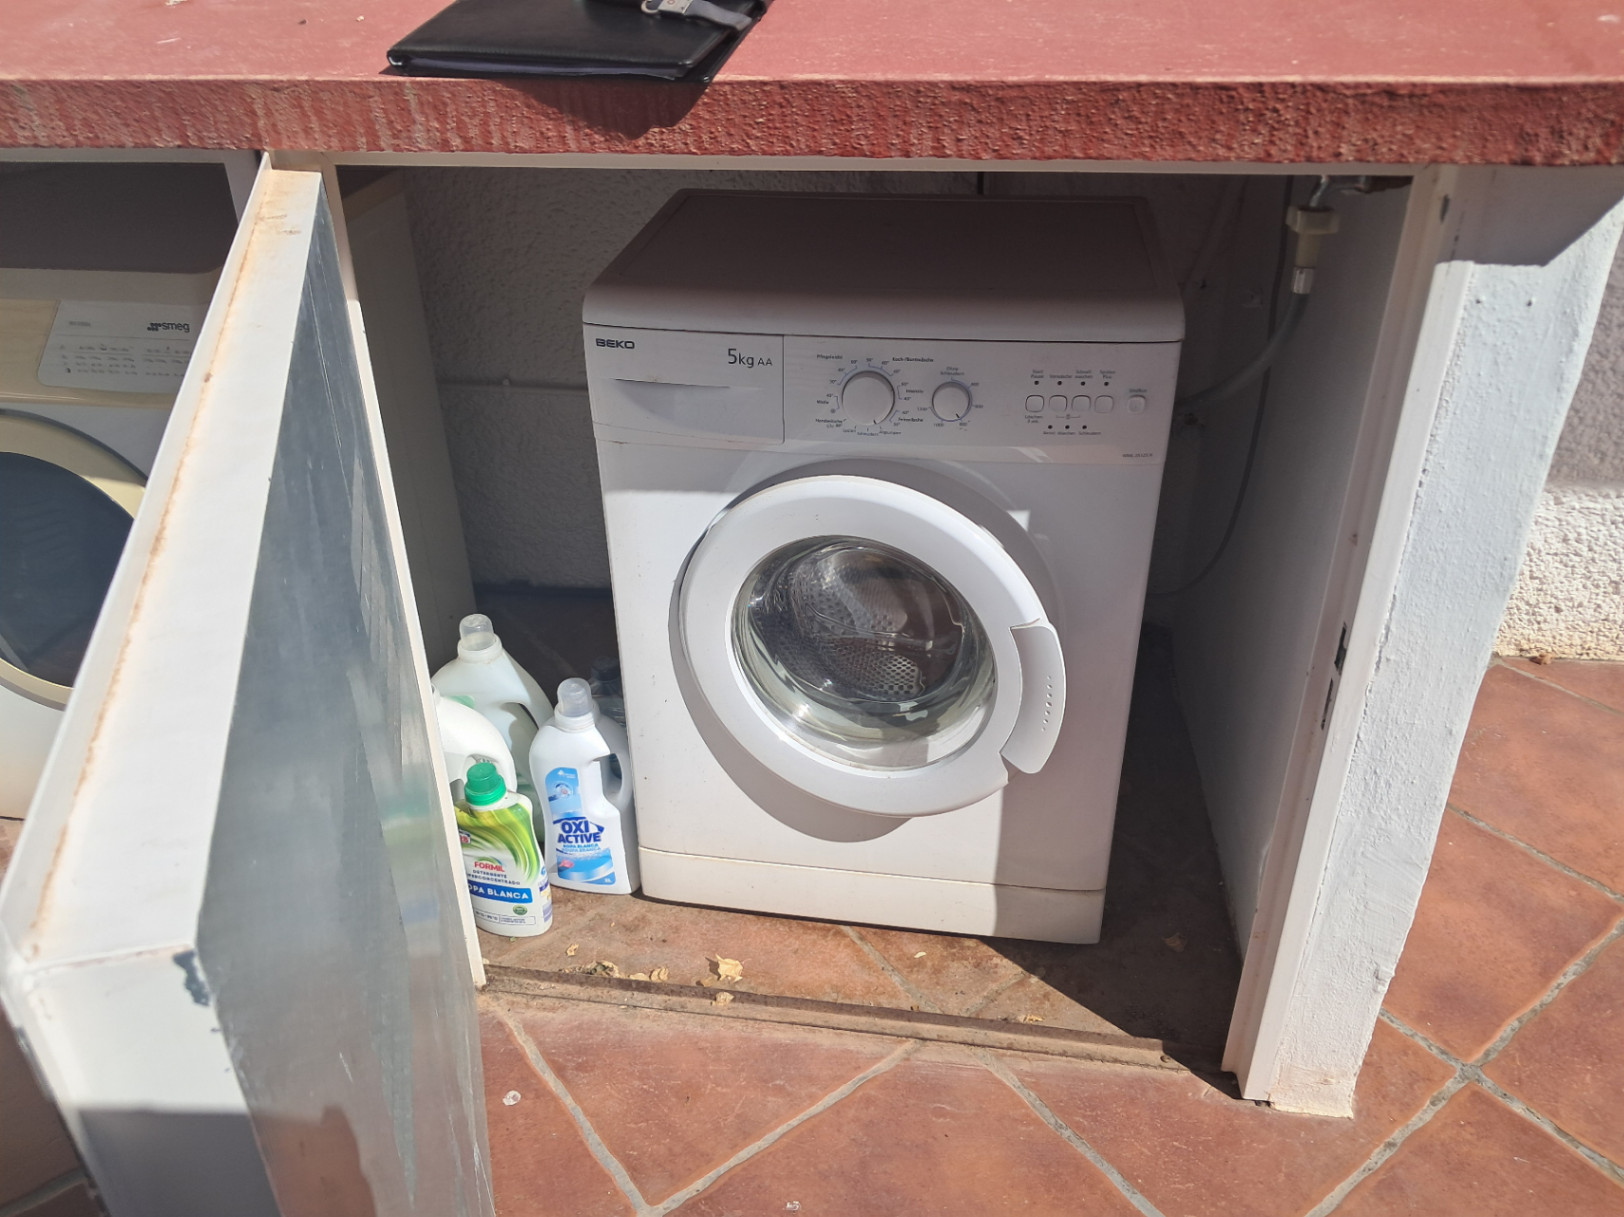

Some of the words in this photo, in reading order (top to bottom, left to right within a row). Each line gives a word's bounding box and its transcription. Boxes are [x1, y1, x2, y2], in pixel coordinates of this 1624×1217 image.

[161, 322, 190, 333] smeg
[595, 338, 635, 349] BEKO
[727, 348, 754, 368] 5kg
[757, 357, 773, 366] AA
[561, 820, 590, 834] OXI
[557, 832, 602, 844] ACTIVE
[474, 861, 505, 872] FORMIL
[468, 884, 485, 894] OPA
[487, 888, 529, 899] BLANCA
